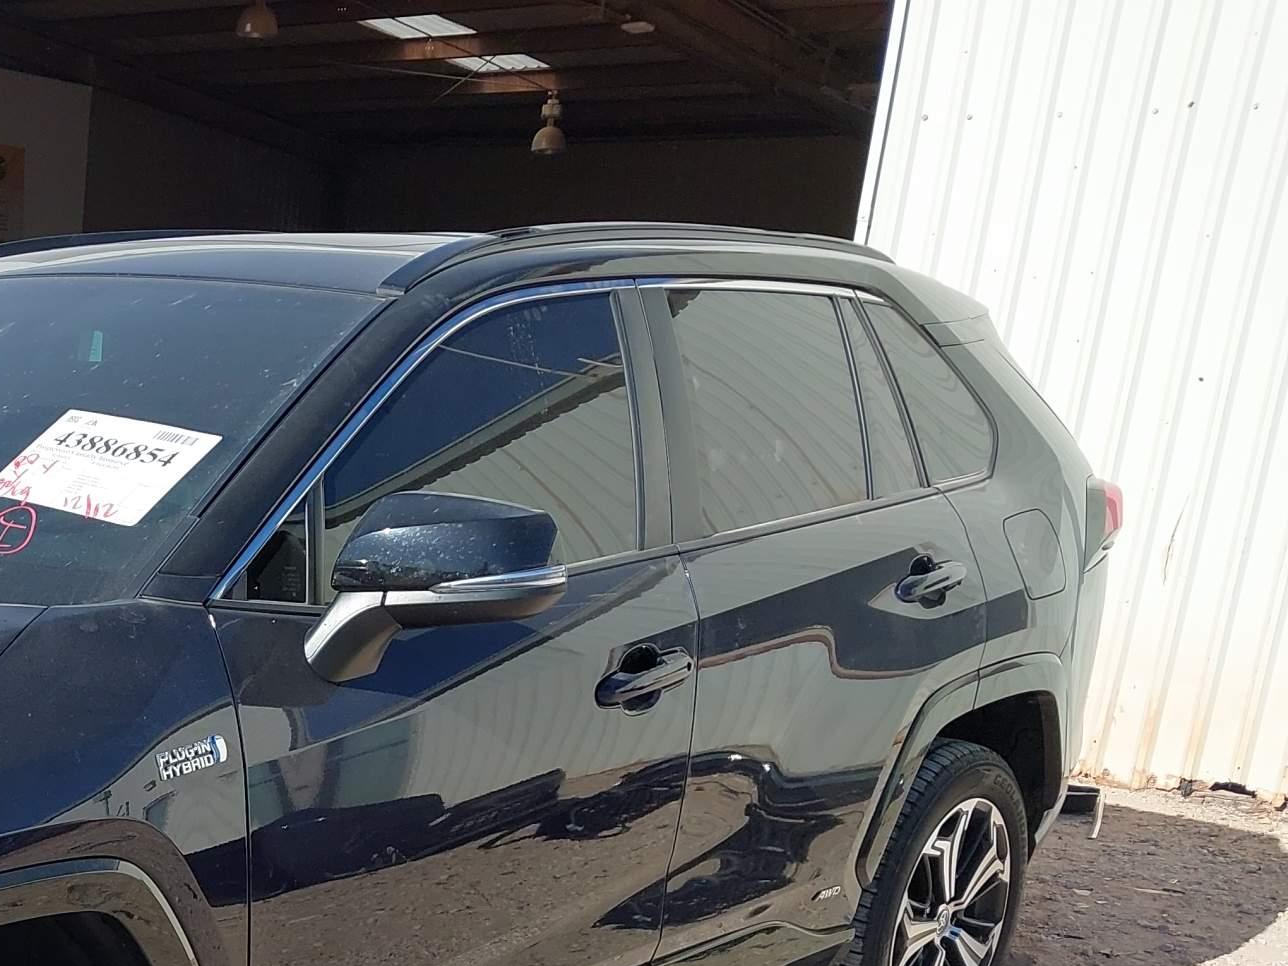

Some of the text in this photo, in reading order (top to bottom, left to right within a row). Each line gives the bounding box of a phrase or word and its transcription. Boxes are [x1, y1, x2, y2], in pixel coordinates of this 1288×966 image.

[53, 430, 181, 467] 43886854
[160, 753, 215, 781] HYBRID
[814, 885, 842, 902] AWD
